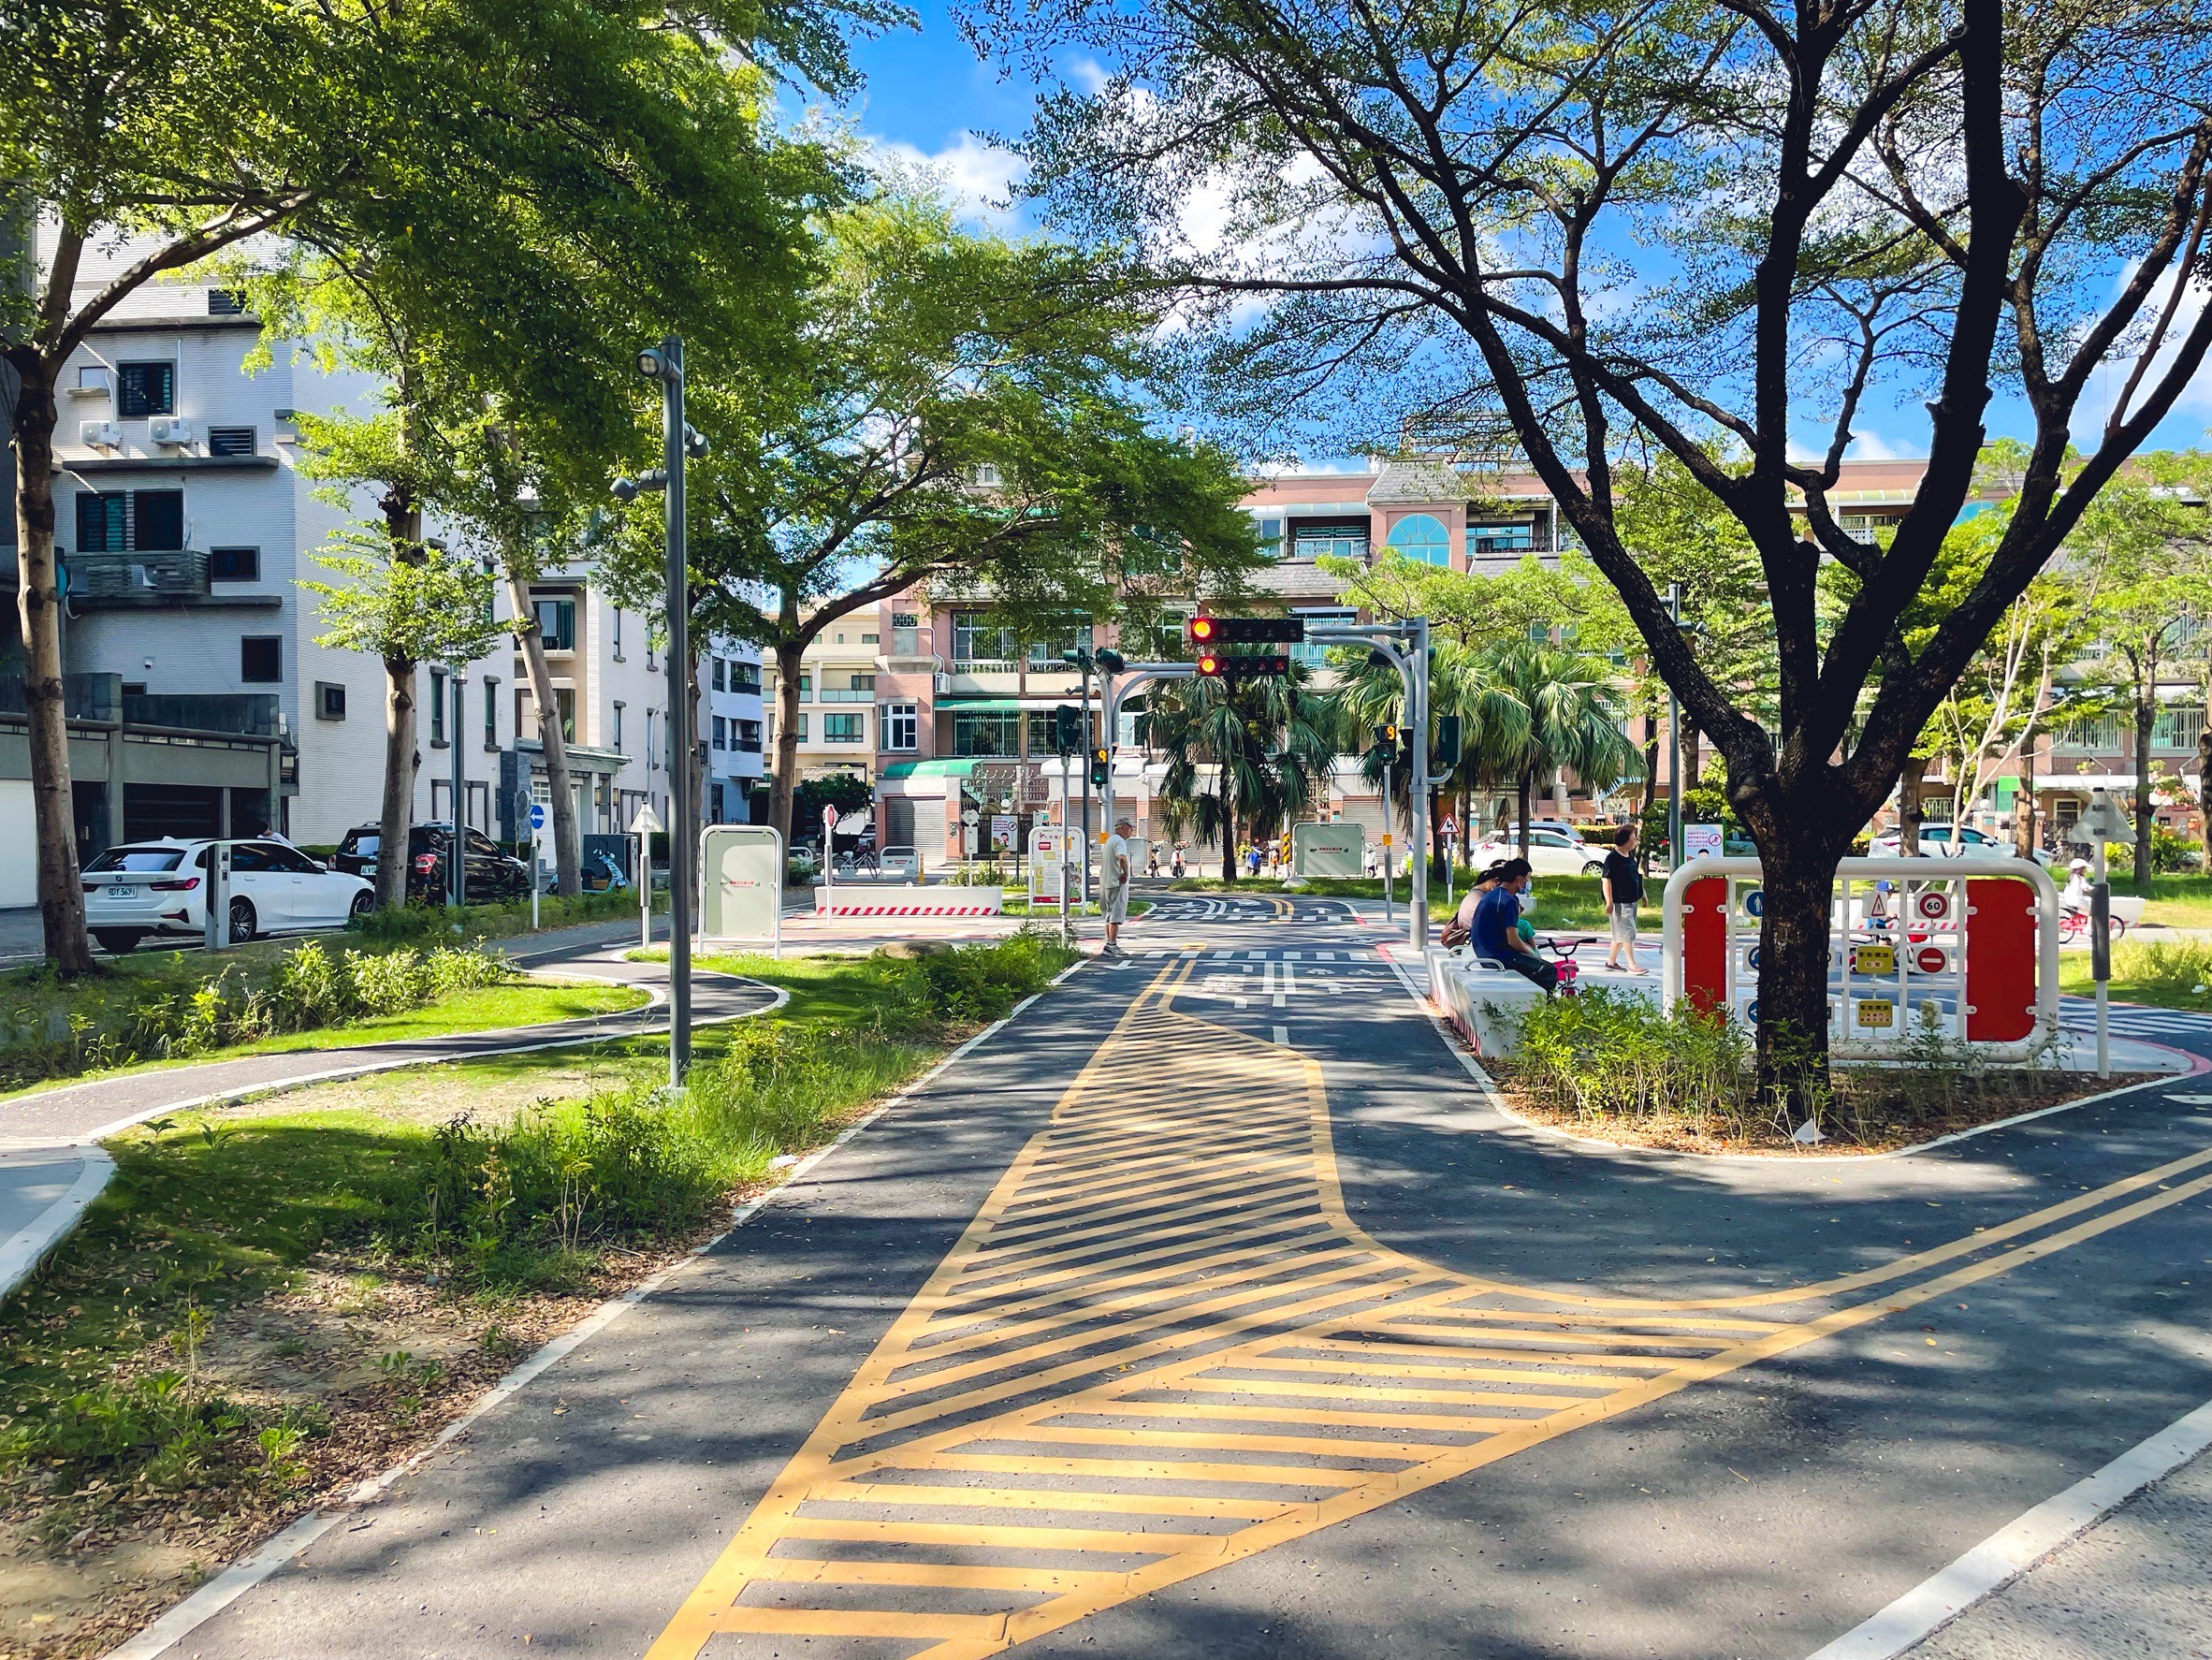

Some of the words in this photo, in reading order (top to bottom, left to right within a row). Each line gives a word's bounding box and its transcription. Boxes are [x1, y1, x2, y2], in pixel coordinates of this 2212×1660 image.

[1387, 725, 1395, 739] 9
[1099, 750, 1107, 763] 9
[1927, 901, 1940, 910] 60
